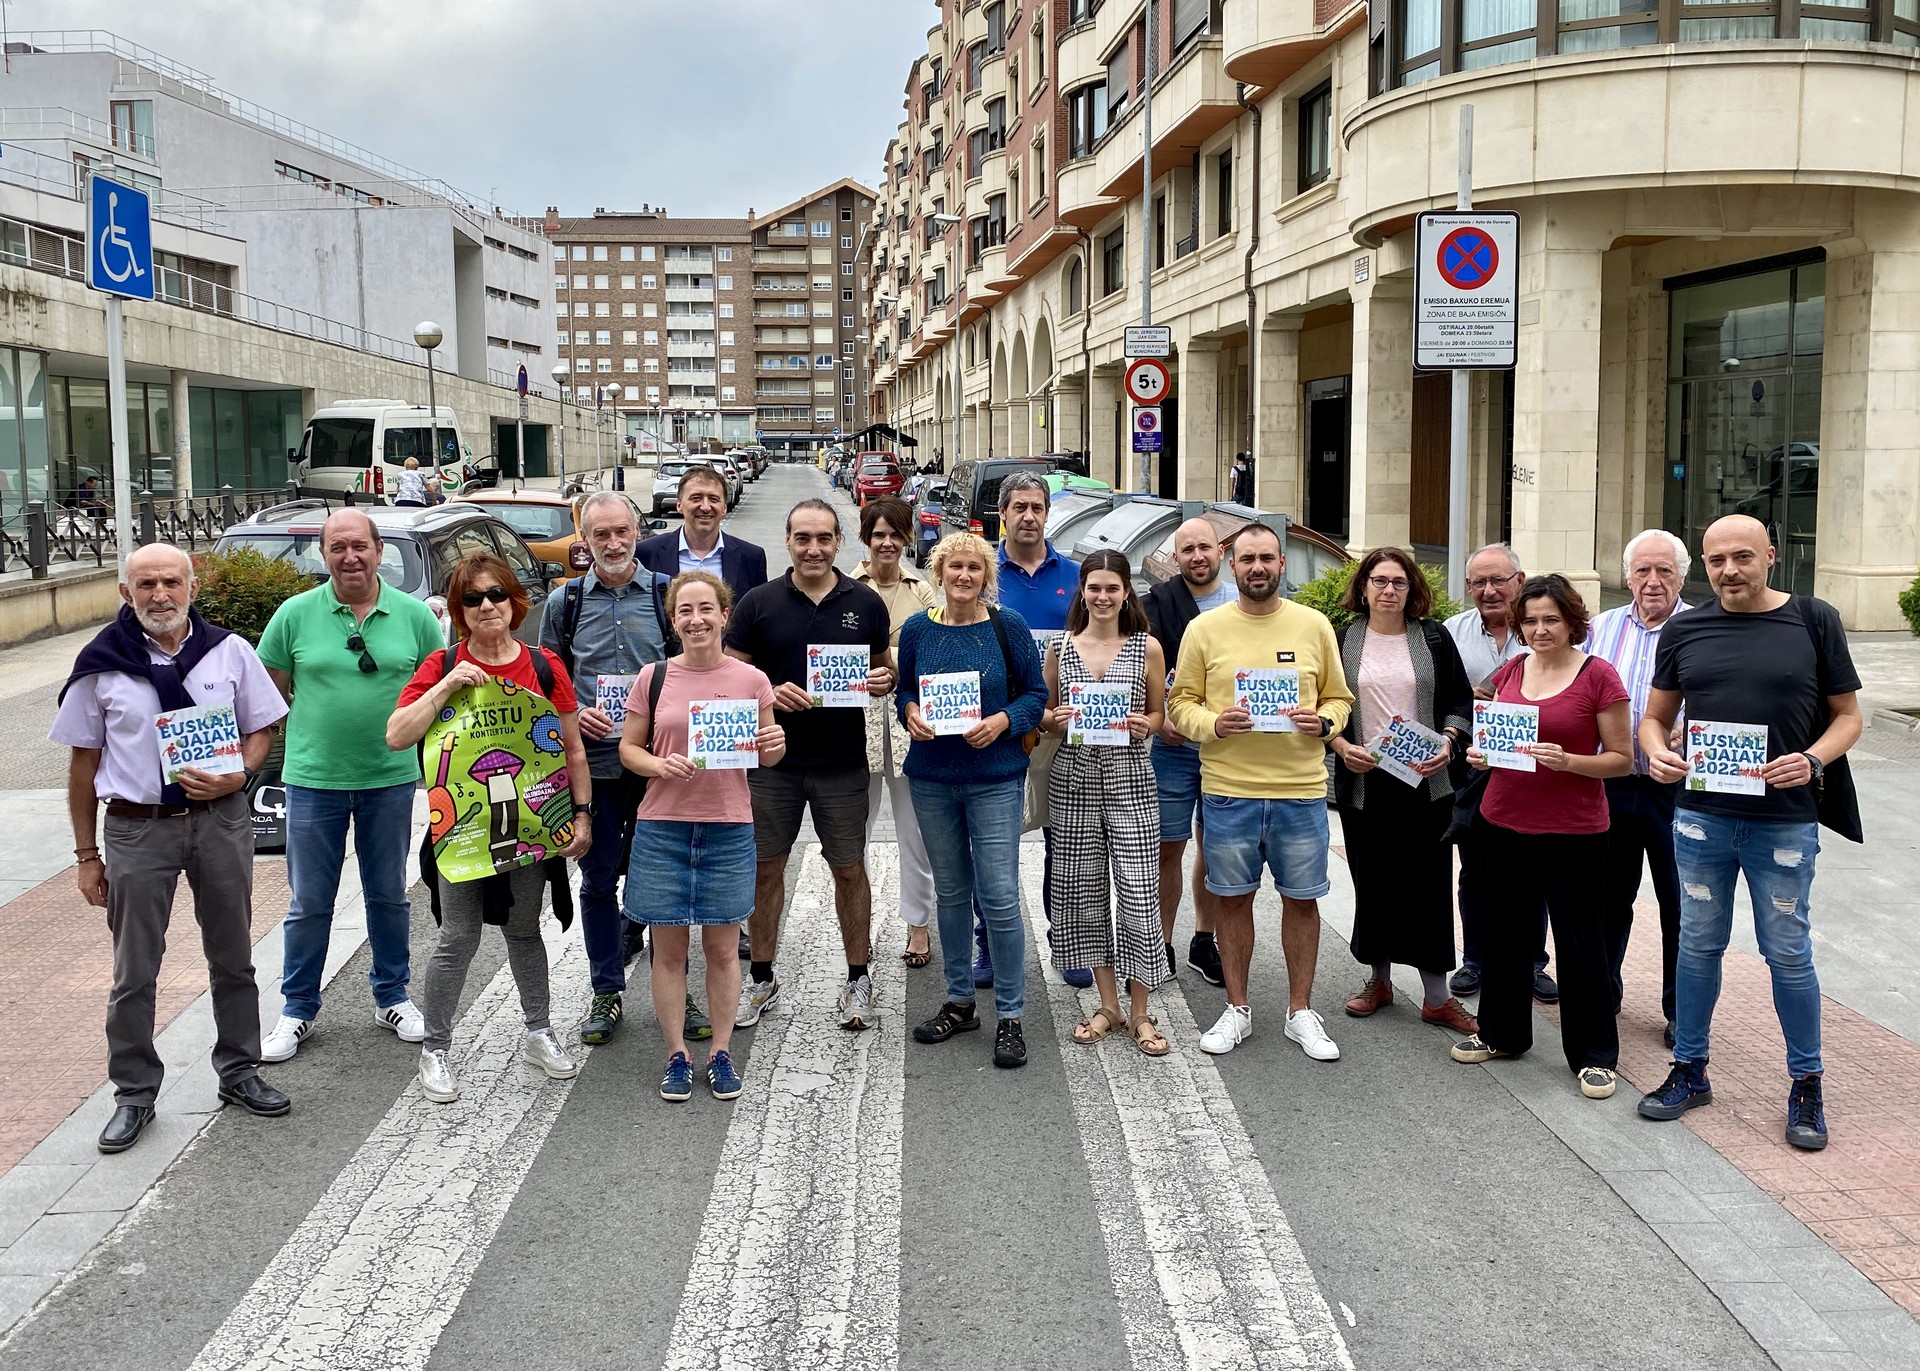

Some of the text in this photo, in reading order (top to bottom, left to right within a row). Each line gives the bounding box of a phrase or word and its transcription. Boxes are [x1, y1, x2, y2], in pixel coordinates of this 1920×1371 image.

[810, 655, 868, 667] EUSKAL
[823, 668, 868, 679] JAIAK
[598, 686, 631, 698] EUSK
[814, 680, 850, 692] 2022
[922, 682, 979, 697] EUSKAL
[1238, 679, 1298, 691] EUSKAL
[935, 694, 979, 708] JAIAK
[1072, 693, 1130, 706] EUSKAL
[1251, 692, 1298, 704] JAIAK
[459, 706, 523, 730] TXISTU
[691, 711, 757, 725] EUSKAL
[927, 707, 961, 721] 2022
[1085, 706, 1129, 718] JAIAK
[160, 713, 235, 740] EUSKAL
[1075, 718, 1110, 730] 2022
[1476, 711, 1537, 729] EUSKAL
[179, 727, 238, 749] JAIAK
[470, 726, 516, 740] KONTZERTUA
[706, 725, 757, 738] JAIAK
[1389, 719, 1438, 755] EUSKAL
[1489, 726, 1536, 742] JAIAK
[696, 739, 736, 752] 2022
[1479, 738, 1516, 753] 2022
[1691, 733, 1766, 750] EUSKAL
[171, 745, 216, 766] 2022
[1379, 742, 1413, 766] 2022
[1707, 748, 1765, 764] JAIAK
[1695, 761, 1741, 777] 2022
